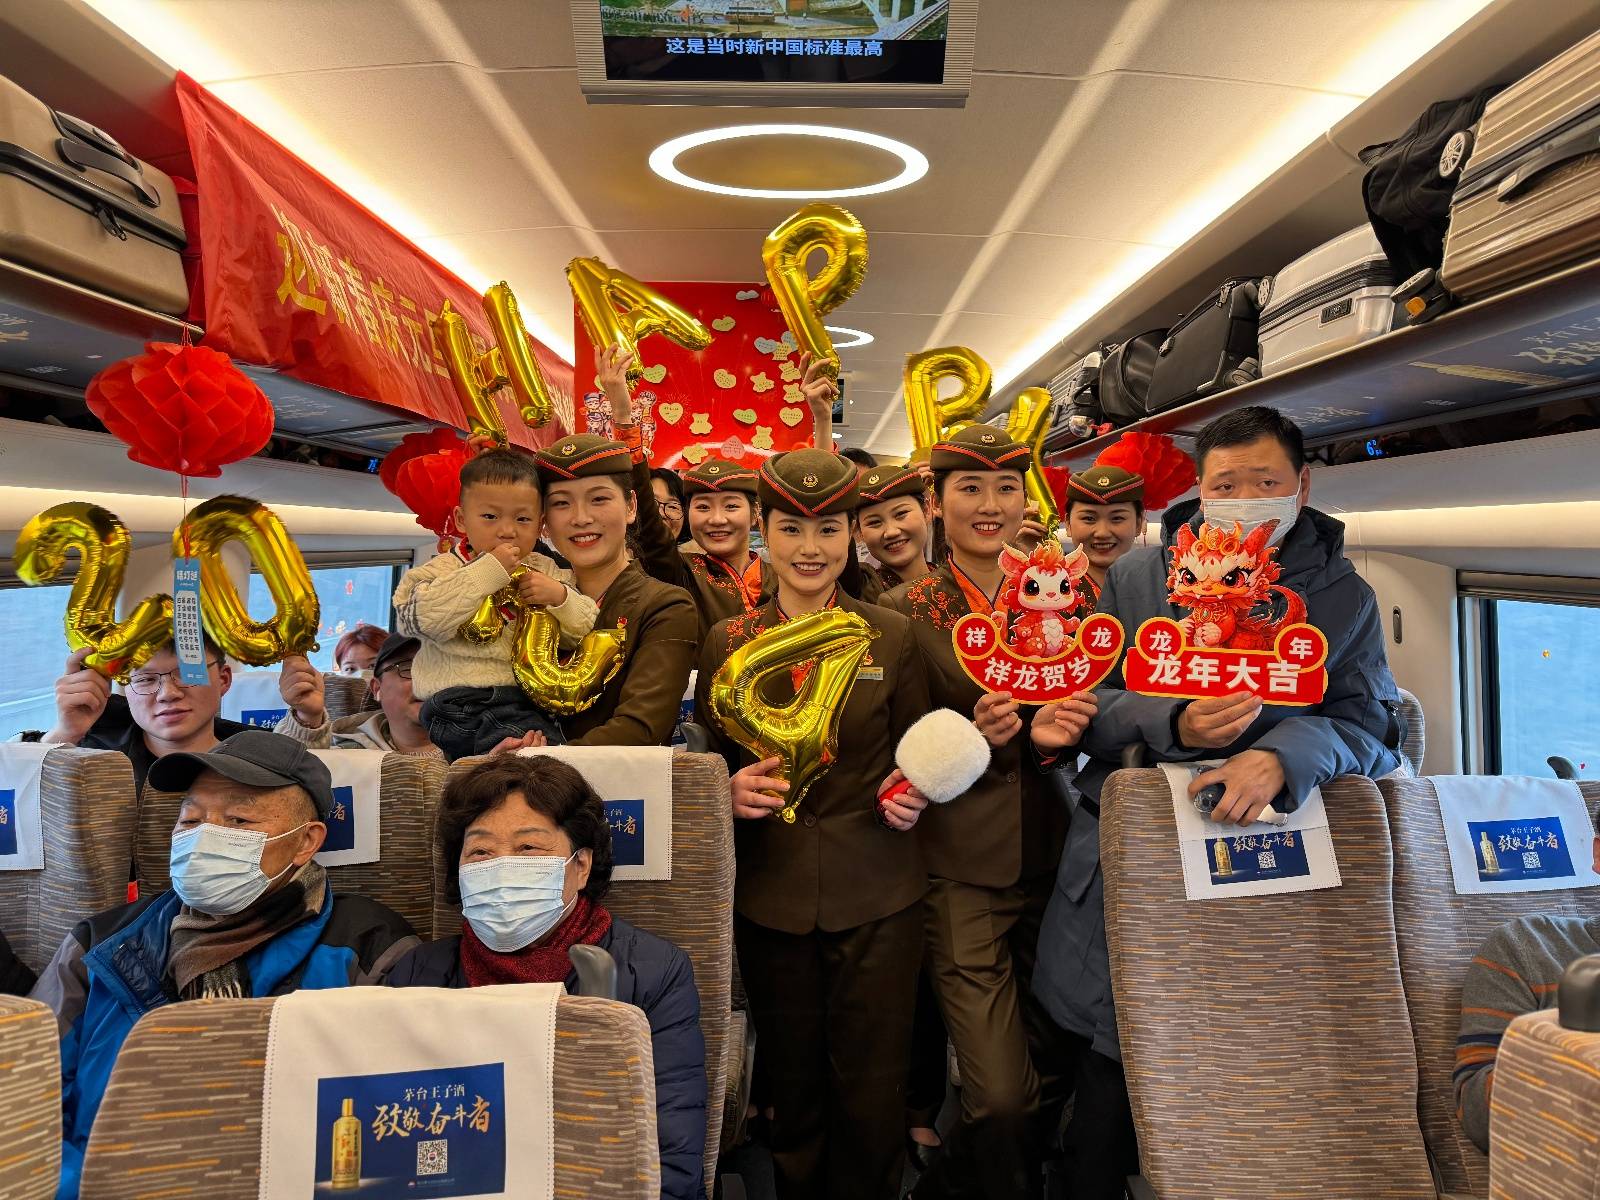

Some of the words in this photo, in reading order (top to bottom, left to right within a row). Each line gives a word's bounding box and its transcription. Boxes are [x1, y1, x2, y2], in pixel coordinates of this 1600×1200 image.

[666, 37, 883, 57] 这是当时新中国标准最高
[965, 626, 988, 649] 祥
[1090, 626, 1113, 648] 龙
[1149, 629, 1173, 652] 龙
[1288, 636, 1314, 660] 年
[984, 654, 1092, 692] 祥龙贺岁
[1147, 652, 1302, 695] 龙年大吉
[1232, 831, 1296, 853] 致敬奋斗者
[1497, 831, 1559, 852] 致敬奋斗者
[403, 1083, 466, 1102] 茅台王子酒
[371, 1095, 491, 1142] 致敬奋斗者
